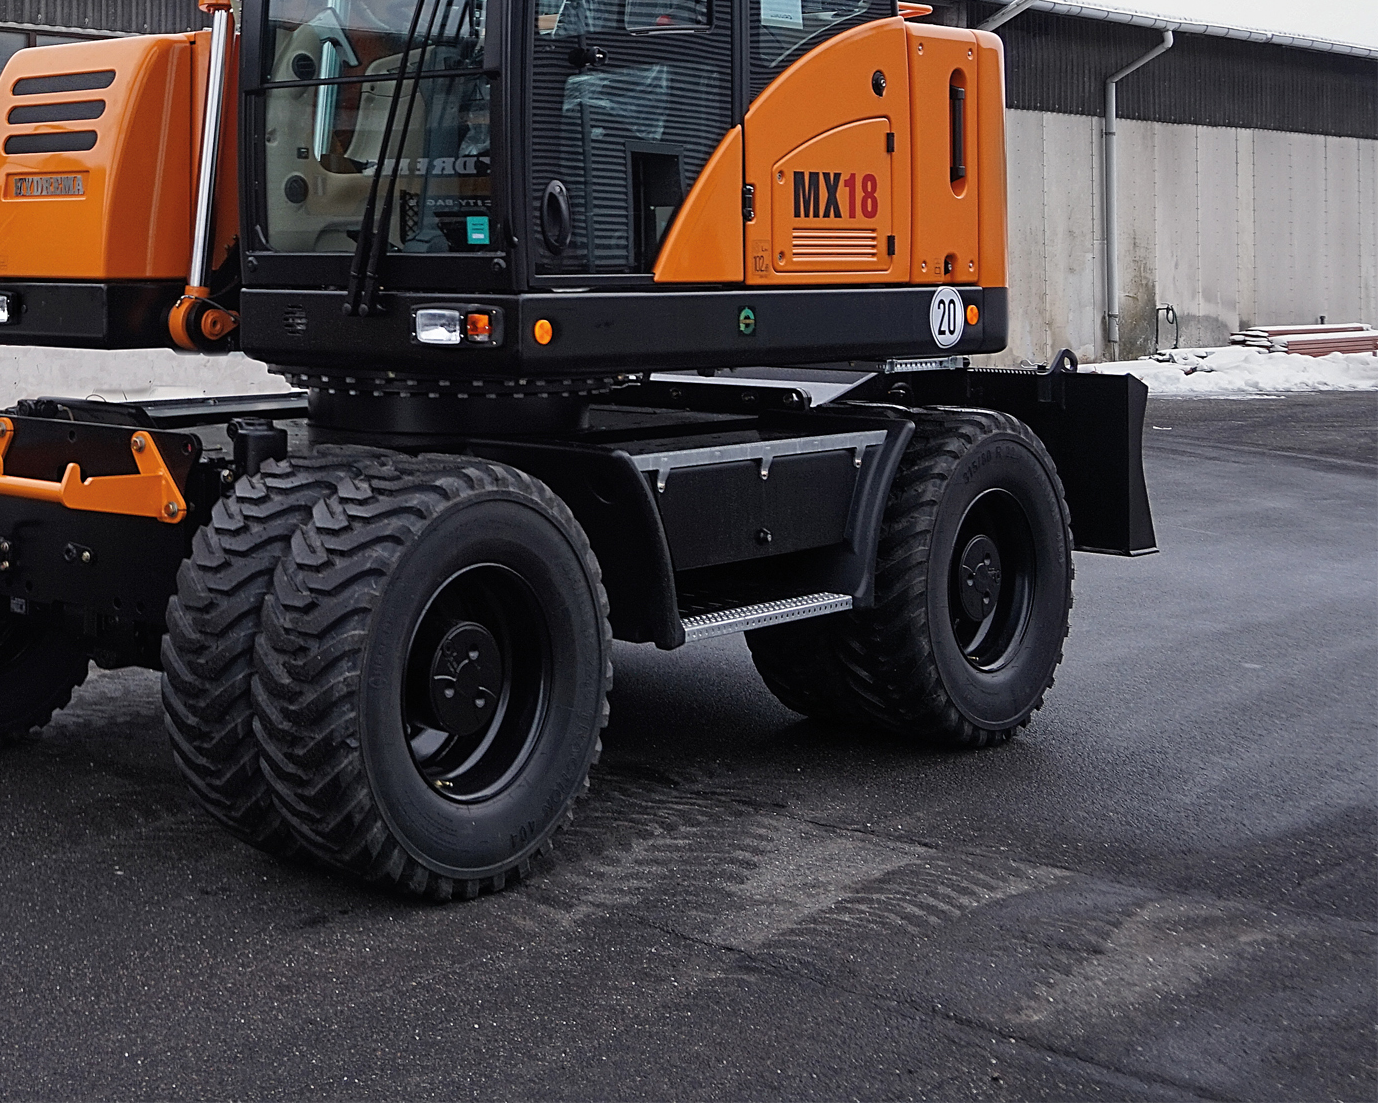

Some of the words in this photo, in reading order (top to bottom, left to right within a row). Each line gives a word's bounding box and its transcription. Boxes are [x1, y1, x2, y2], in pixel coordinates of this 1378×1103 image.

[14, 175, 85, 197] HYDREMA
[793, 171, 878, 219] MX18
[937, 298, 956, 335] 20
